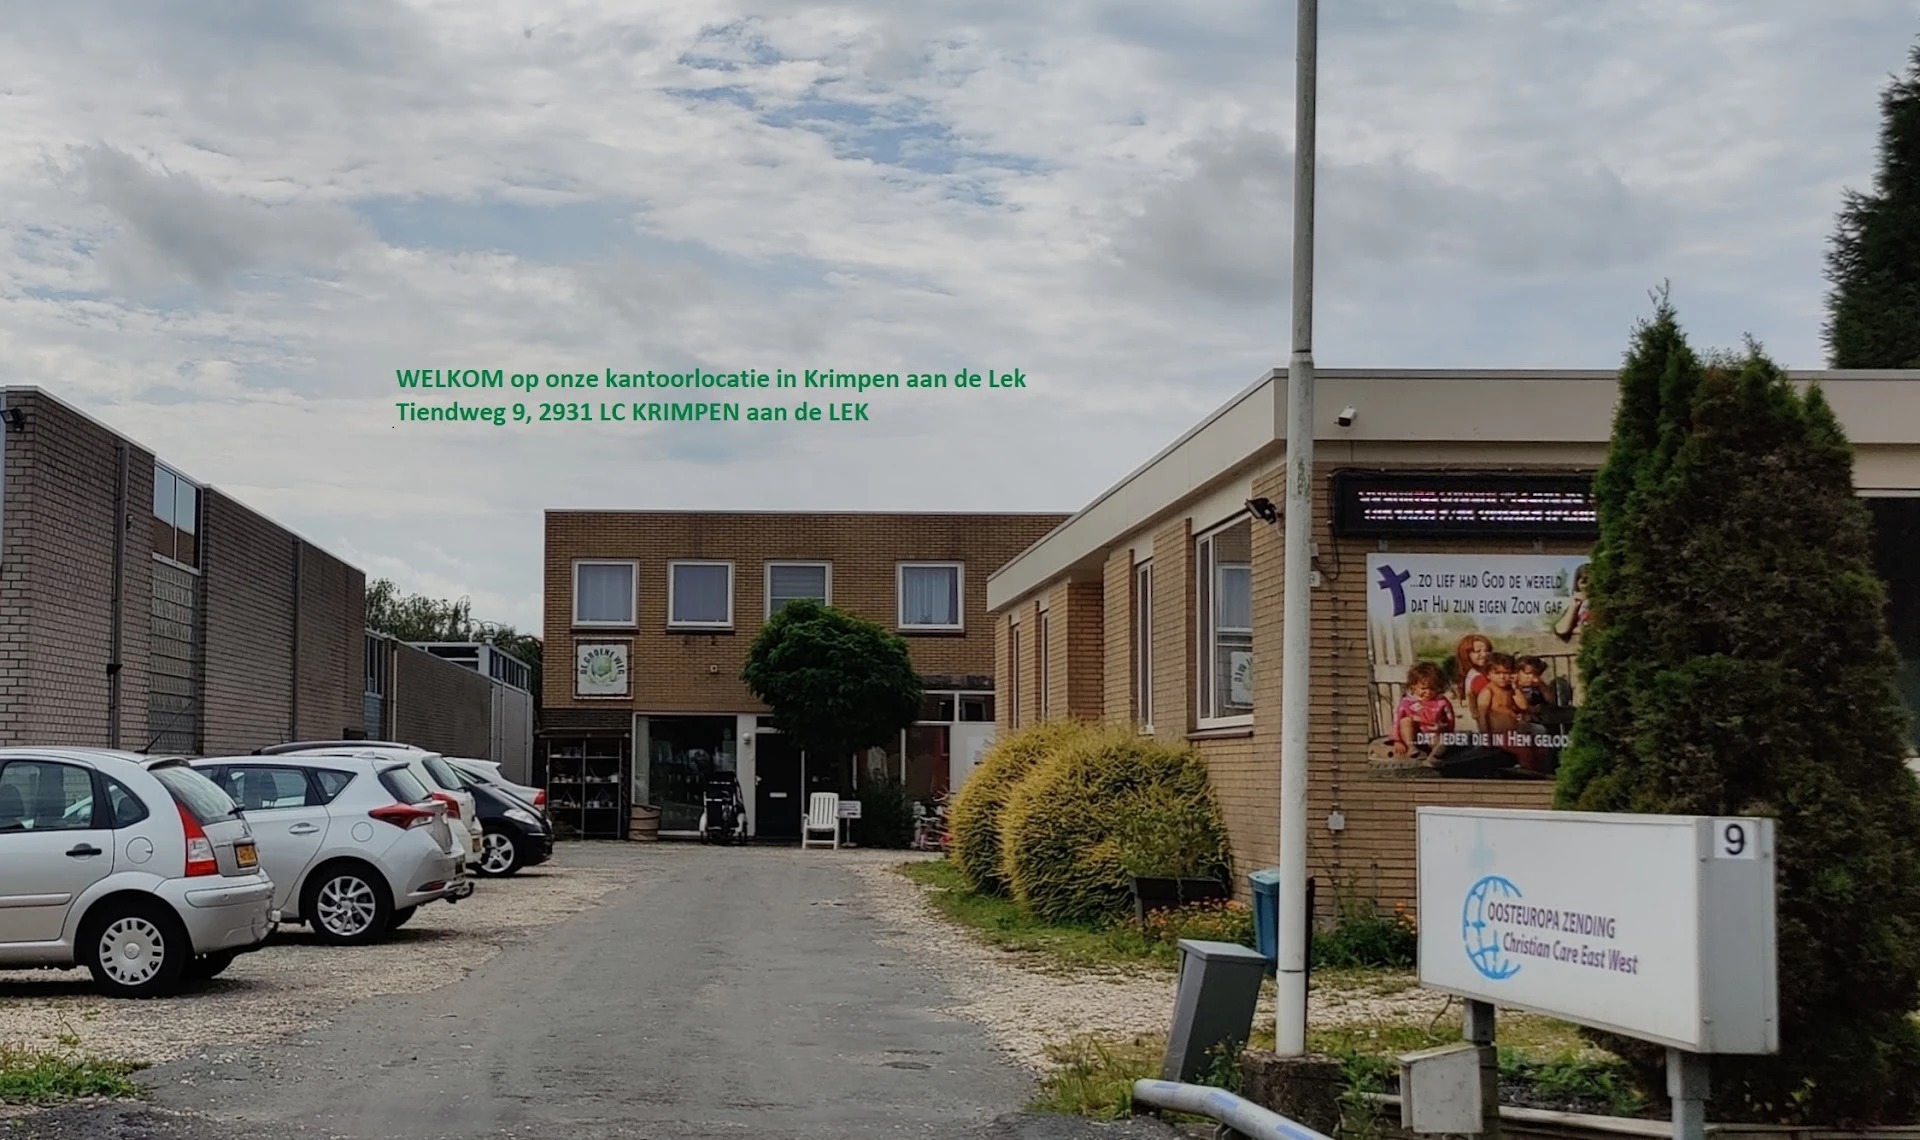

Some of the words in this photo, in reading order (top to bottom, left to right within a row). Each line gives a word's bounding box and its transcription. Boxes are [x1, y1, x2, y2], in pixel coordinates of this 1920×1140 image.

[1436, 574, 1455, 588] LIEF
[1459, 574, 1478, 588] HAD
[1509, 575, 1521, 589] DE
[1525, 575, 1562, 590] WERELD
[1411, 599, 1428, 613] DAT
[1453, 600, 1474, 613] ZIJN
[1479, 600, 1506, 614] EIGEN
[1440, 733, 1468, 746] IEDER
[1472, 733, 1489, 746] DIE
[1492, 733, 1504, 746] IN
[1534, 734, 1570, 748] GELOO
[1724, 823, 1745, 856] 9
[1487, 902, 1559, 931] OOSTEUROPA
[1562, 911, 1616, 939] ZENDING
[1502, 931, 1550, 959] Christian
[1552, 940, 1577, 966] Care
[1580, 944, 1606, 969] East
[1608, 949, 1639, 975] West
